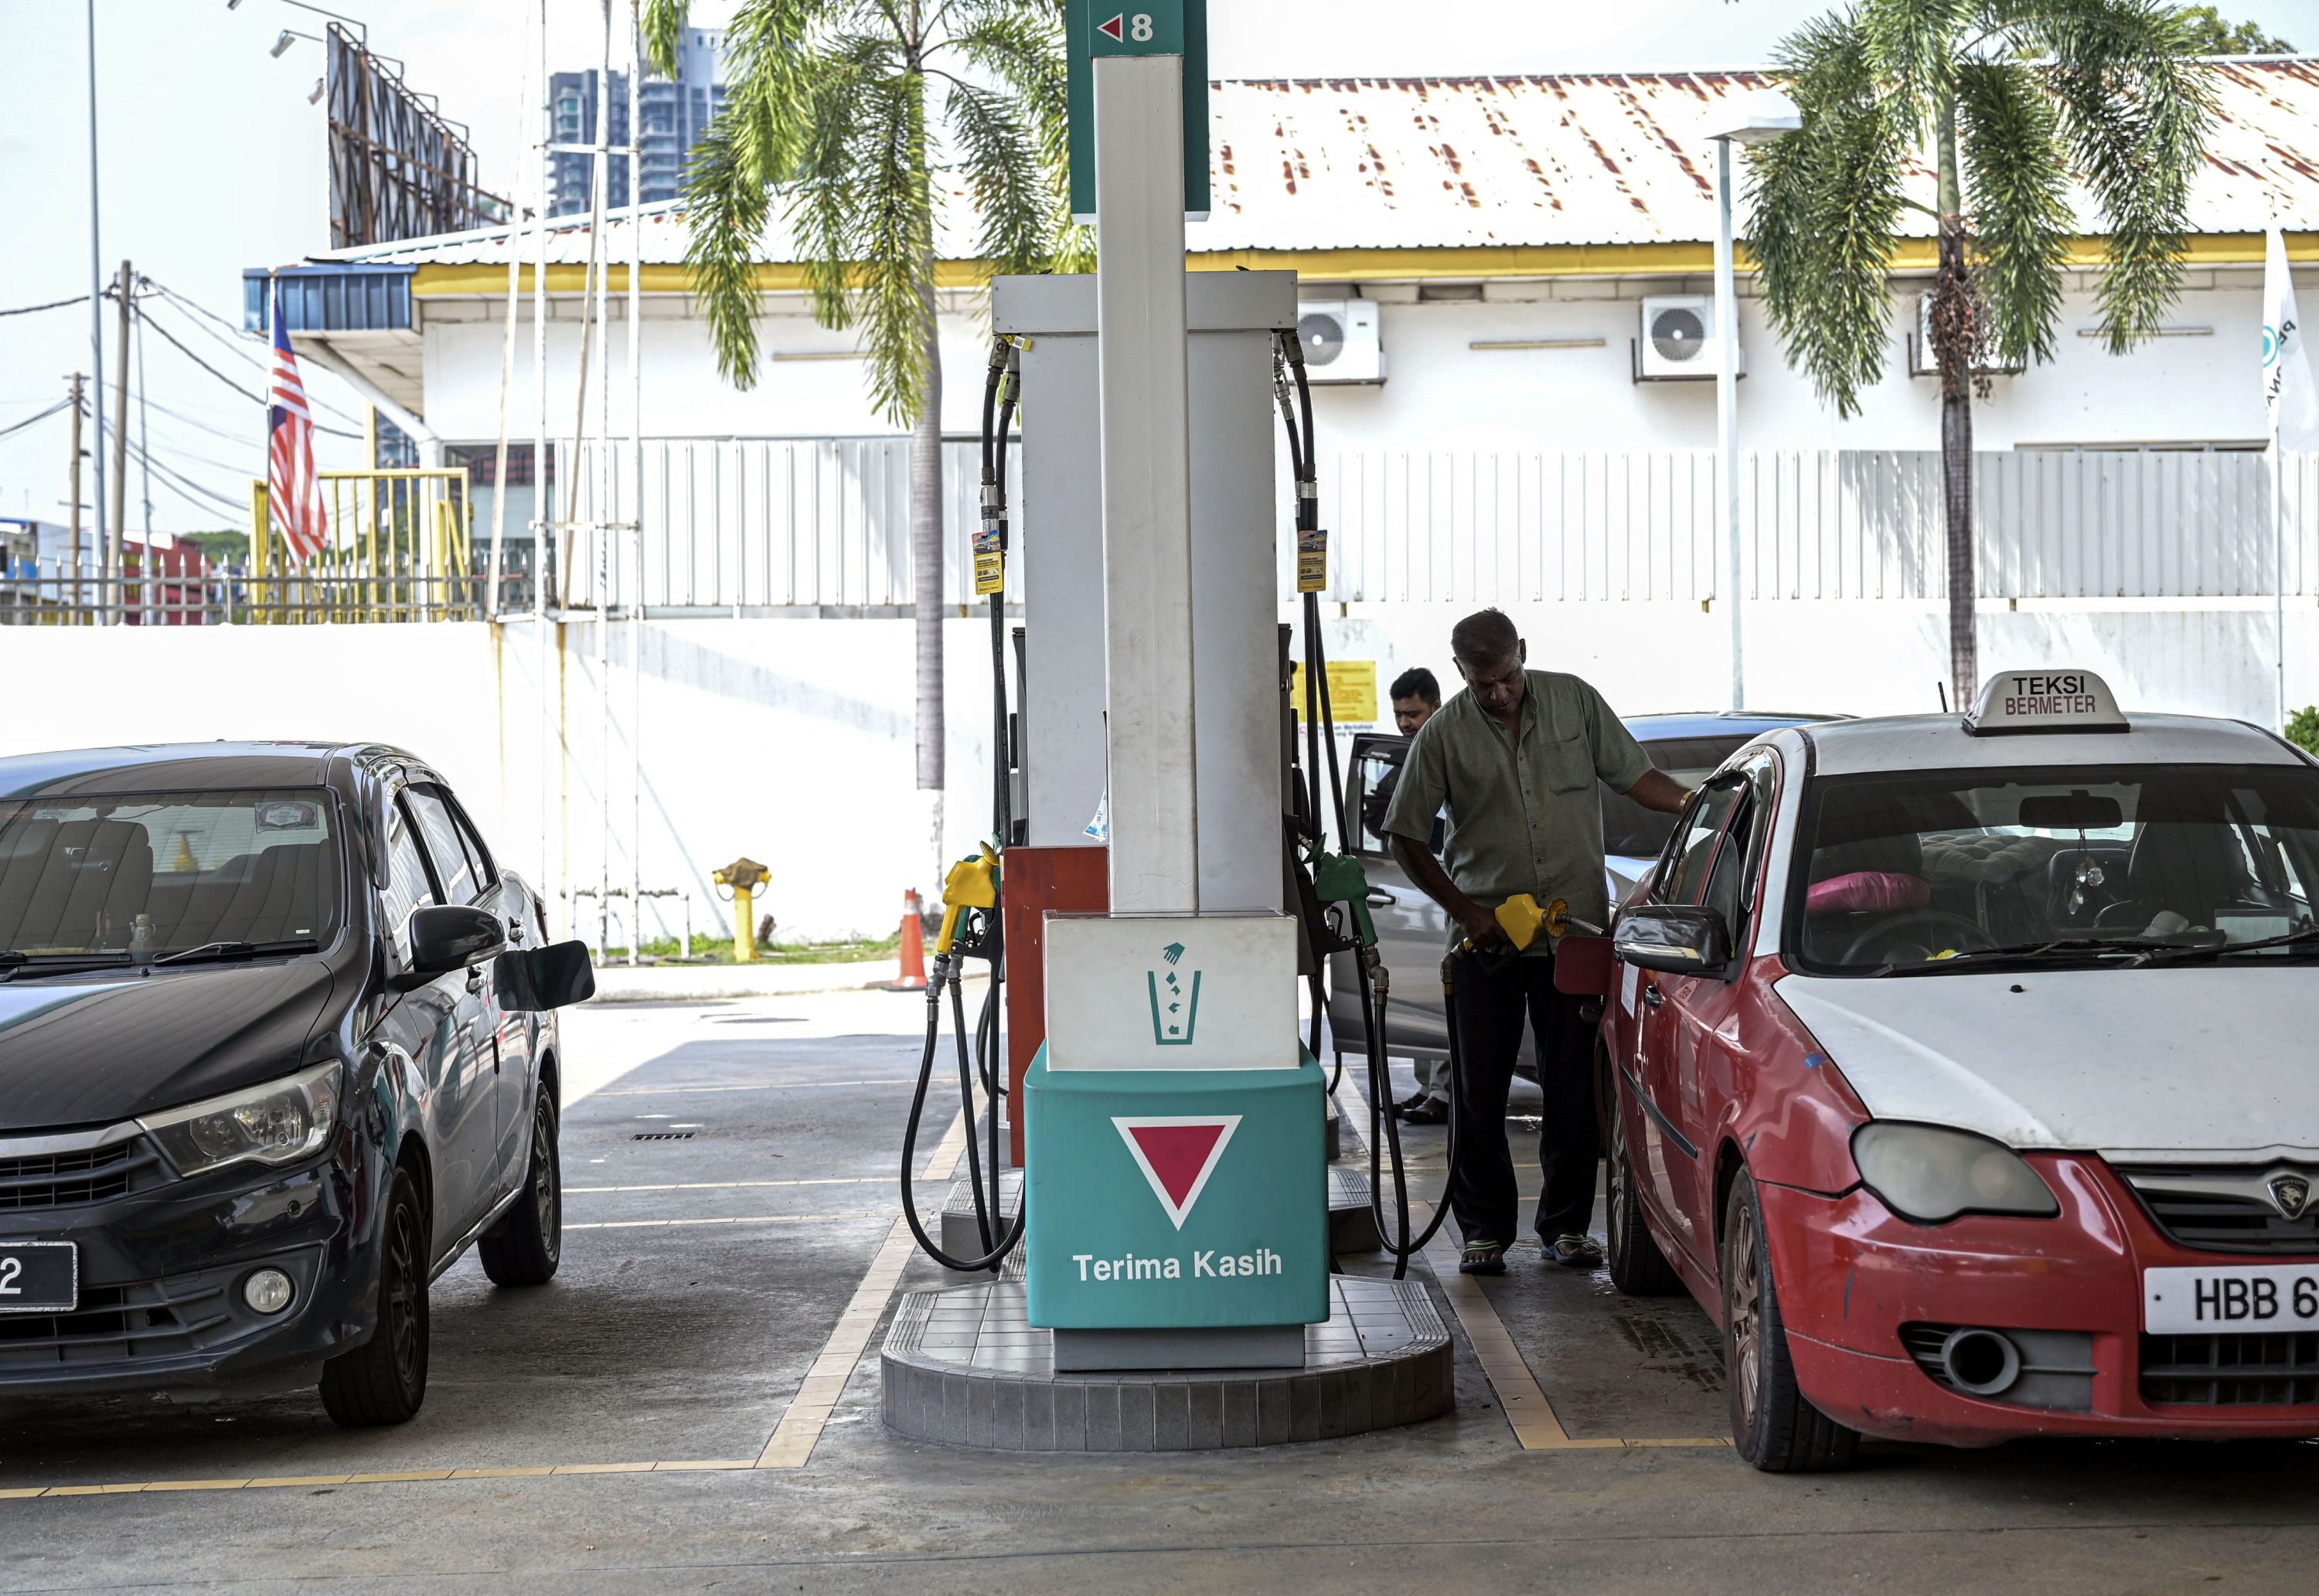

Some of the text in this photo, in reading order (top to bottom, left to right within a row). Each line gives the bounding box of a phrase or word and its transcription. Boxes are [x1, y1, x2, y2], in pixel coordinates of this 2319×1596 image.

[1131, 13, 1153, 42] 8
[2012, 675, 2085, 695] TEKSI
[2005, 695, 2096, 716] BERMETER
[0, 1257, 22, 1294] 2
[1072, 1248, 1282, 1281] Terima Kasih
[2195, 1277, 2318, 1320] HBB 6
